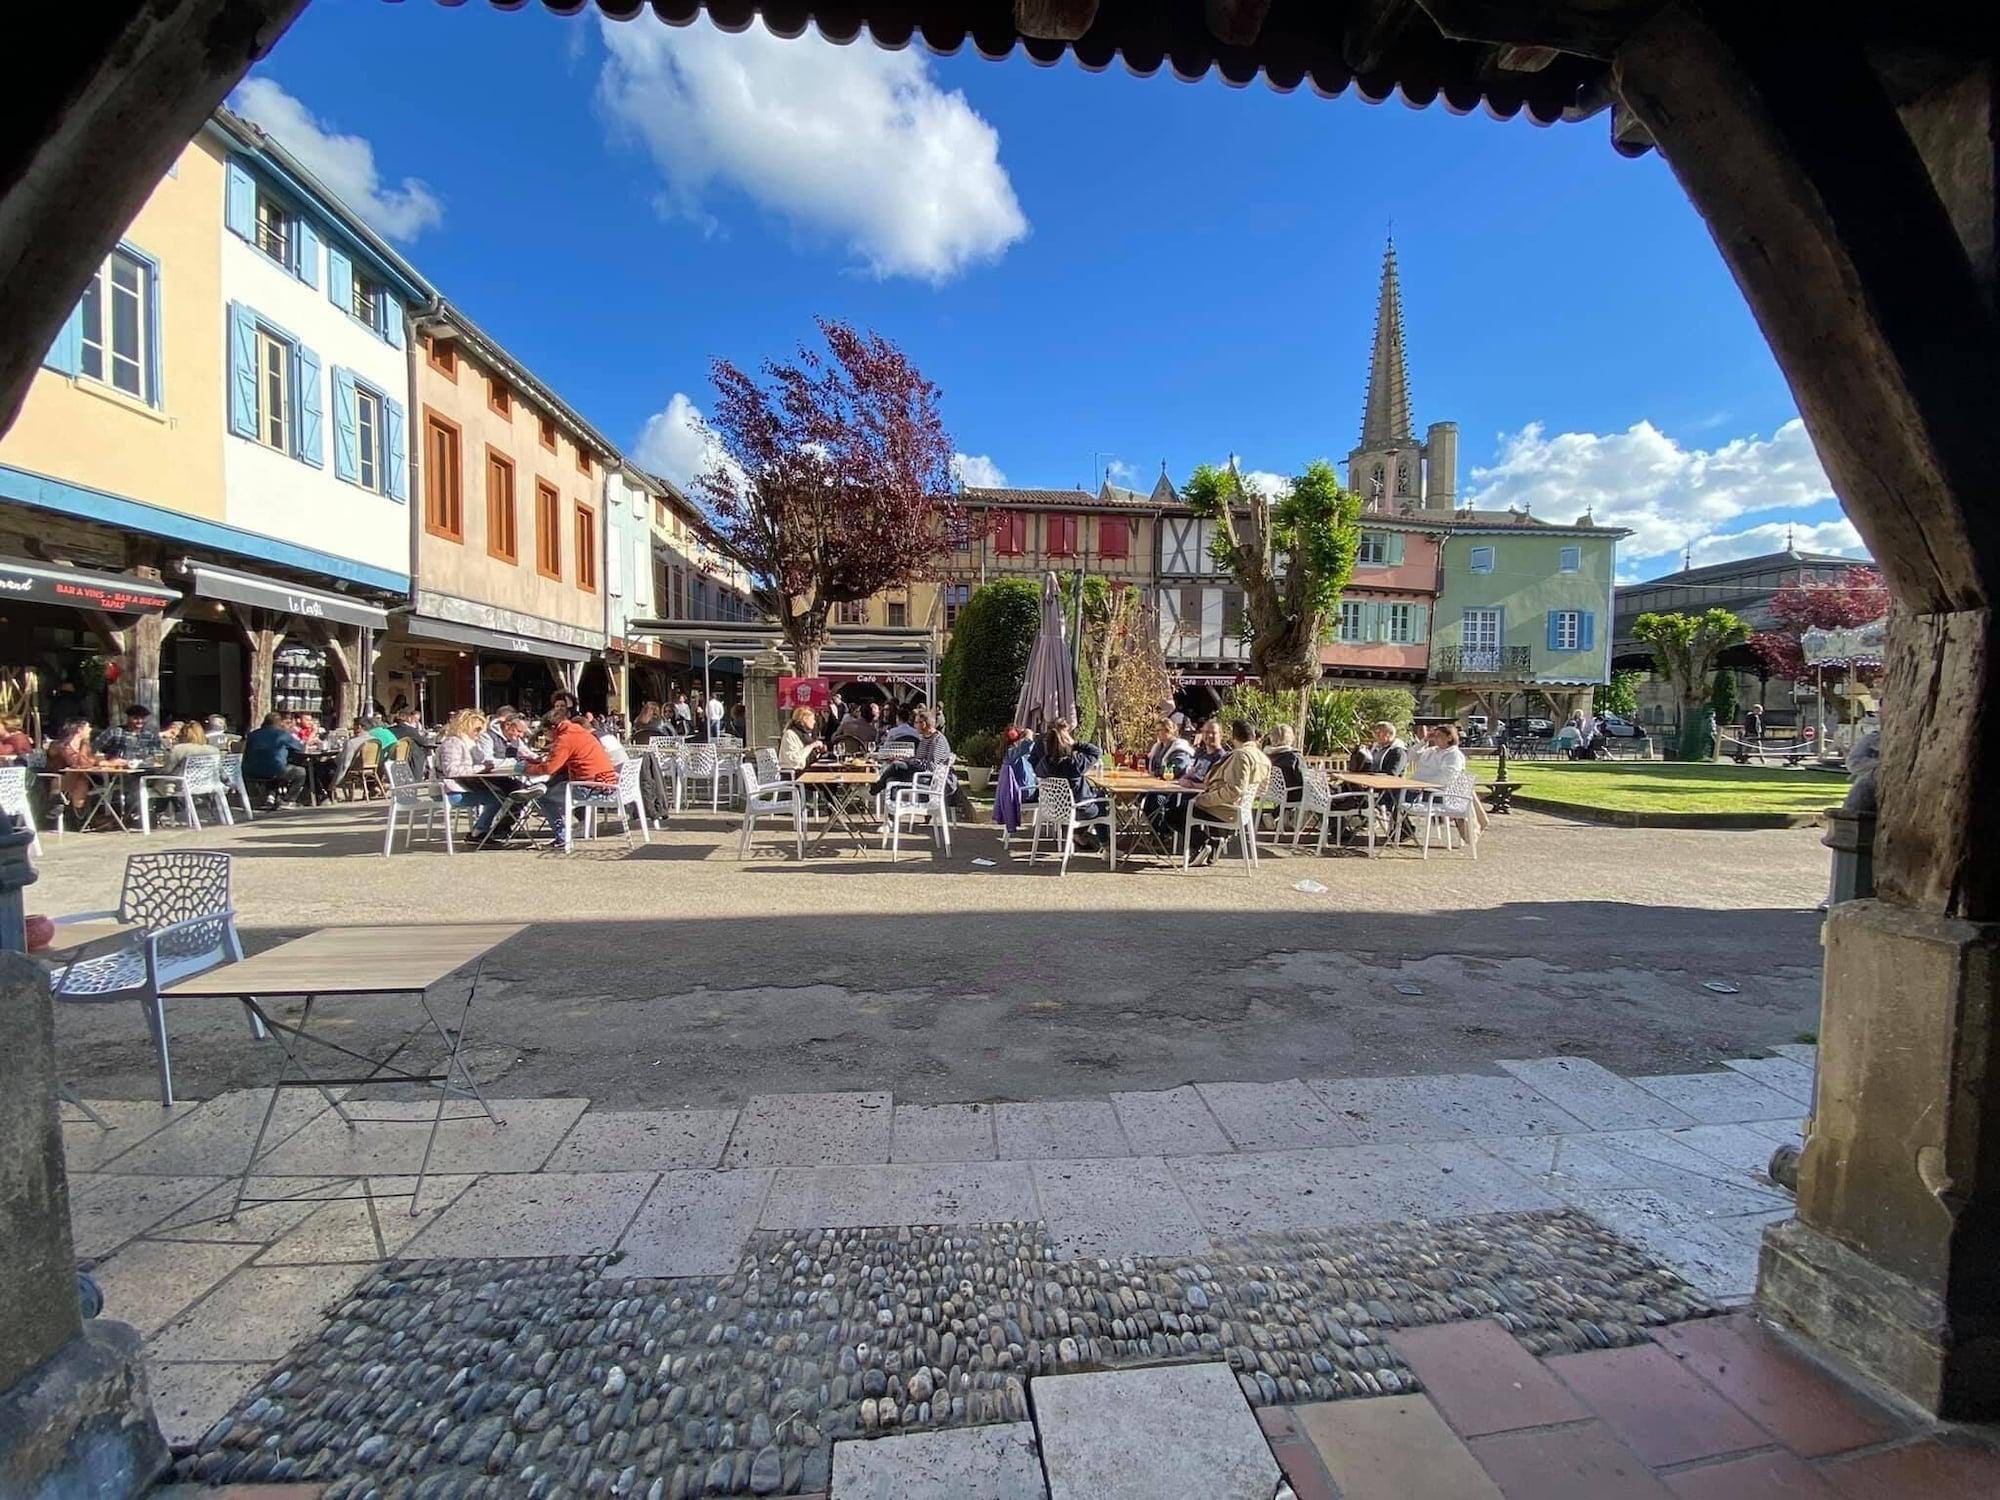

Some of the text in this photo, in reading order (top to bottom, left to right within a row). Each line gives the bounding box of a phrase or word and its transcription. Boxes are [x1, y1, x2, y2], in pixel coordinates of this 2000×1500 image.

[56, 584, 75, 593] BAR
[84, 589, 104, 598] VINS
[114, 593, 131, 602] BAR
[101, 599, 126, 609] TAPAS
[289, 596, 300, 612] Le
